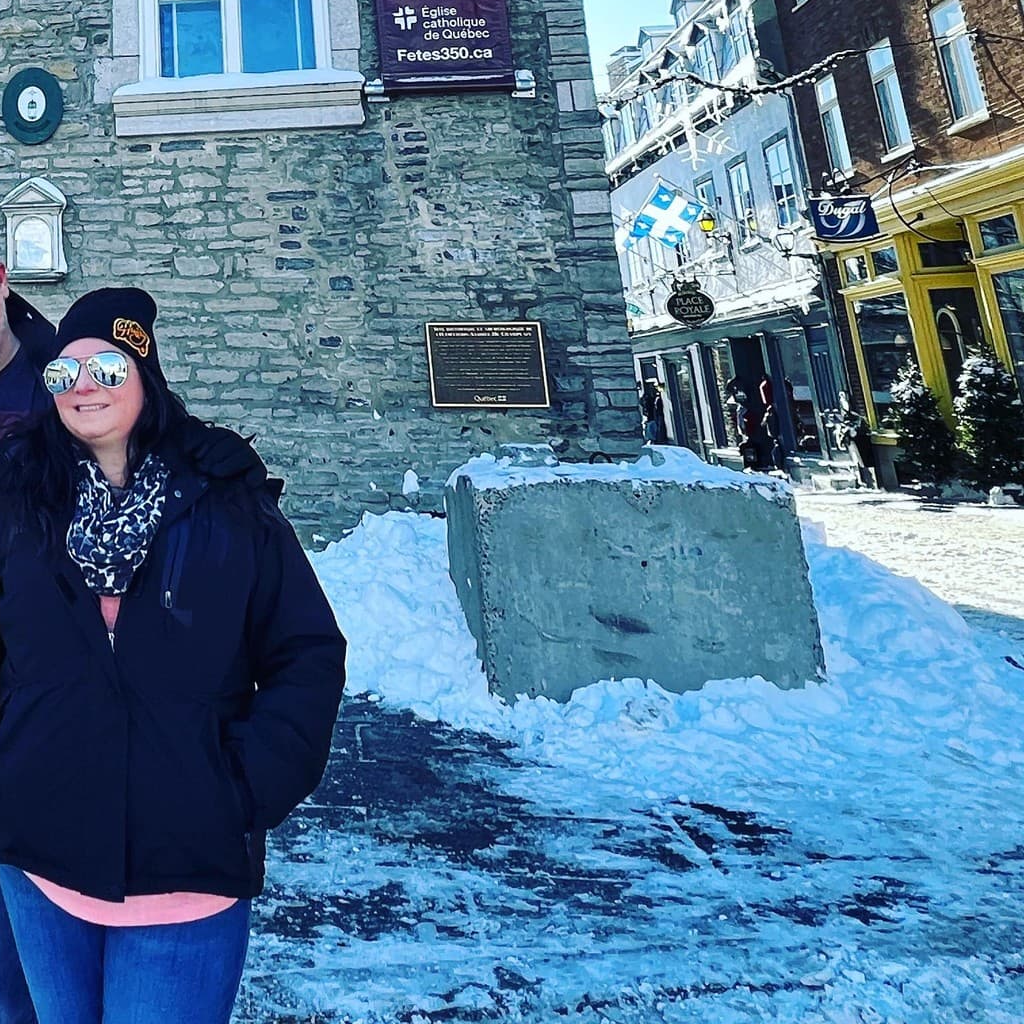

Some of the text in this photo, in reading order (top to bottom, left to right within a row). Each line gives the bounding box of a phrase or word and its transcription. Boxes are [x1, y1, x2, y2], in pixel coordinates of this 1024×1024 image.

[421, 5, 457, 19] Église
[422, 17, 486, 29] catholique
[424, 28, 490, 41] de Québec
[397, 46, 493, 62] Fetes350.ca
[817, 200, 867, 220] Dugal
[675, 296, 705, 306] PLACE
